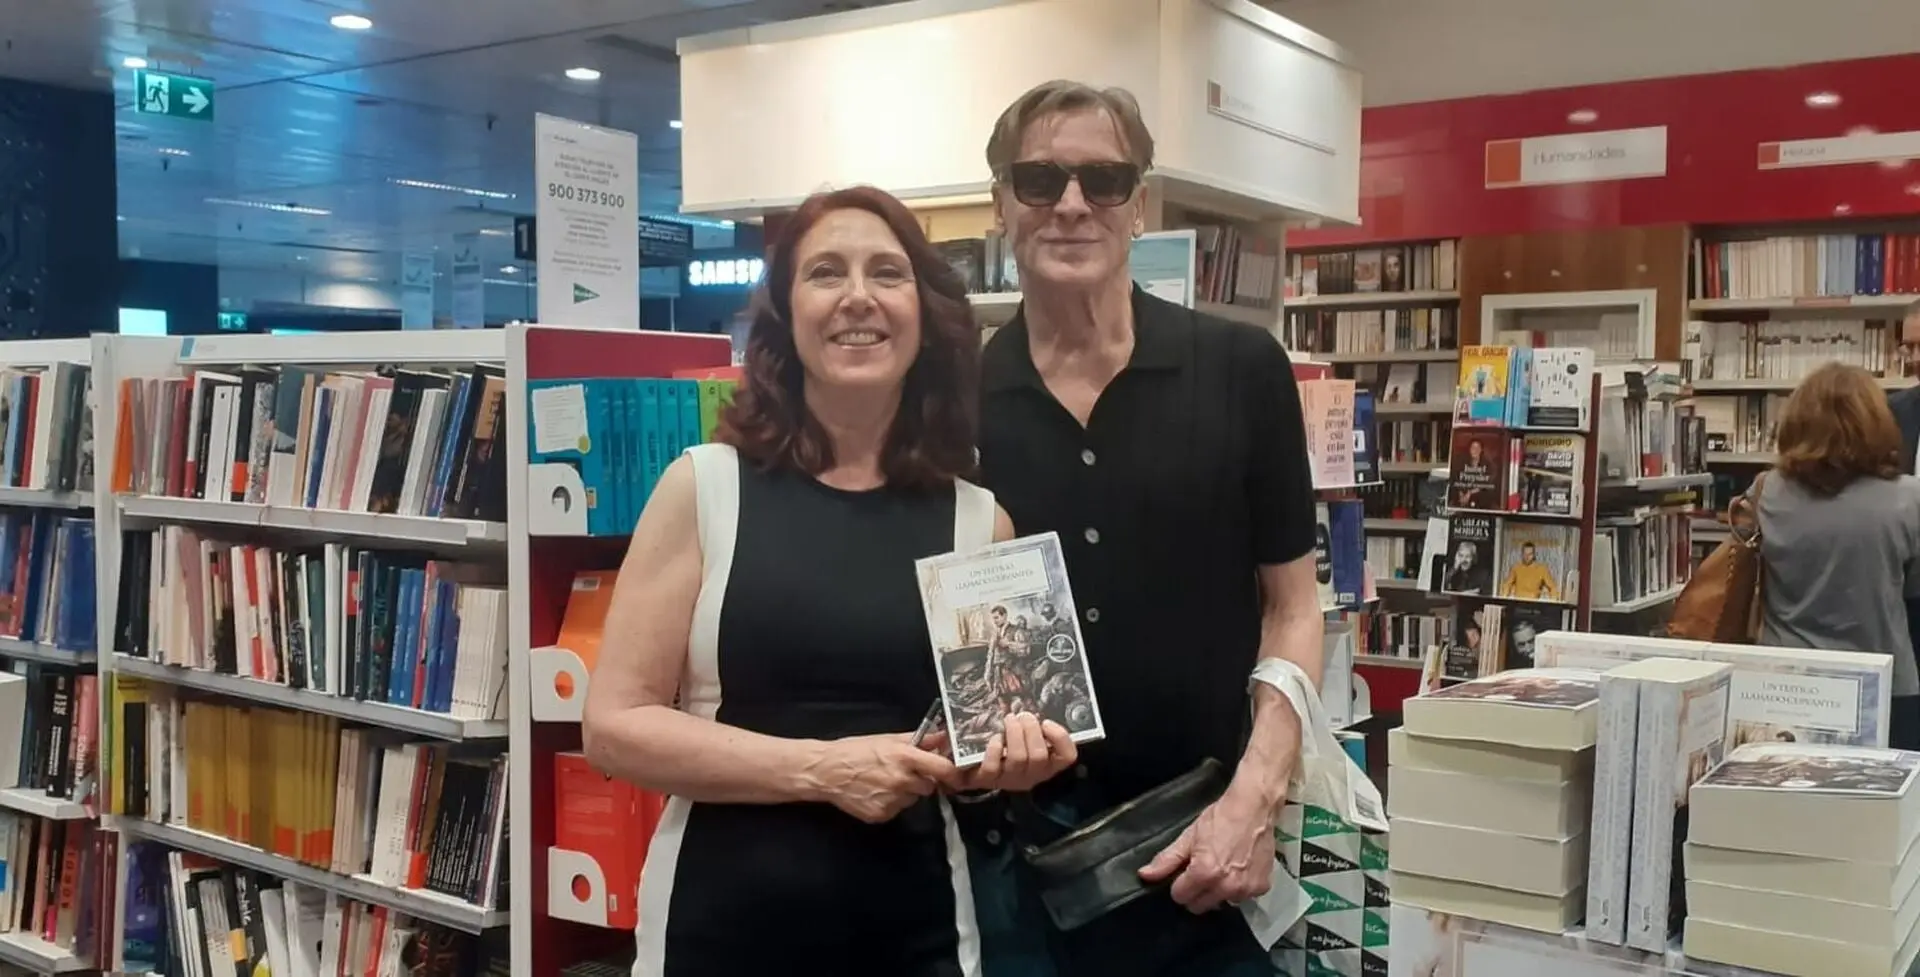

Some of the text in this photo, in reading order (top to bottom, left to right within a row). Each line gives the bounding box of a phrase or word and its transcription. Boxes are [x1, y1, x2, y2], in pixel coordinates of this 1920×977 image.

[1533, 146, 1626, 165] Humanidades
[548, 182, 625, 209] 900 373 900
[689, 258, 765, 287] SAMSU
[1454, 517, 1490, 528] CARLOS
